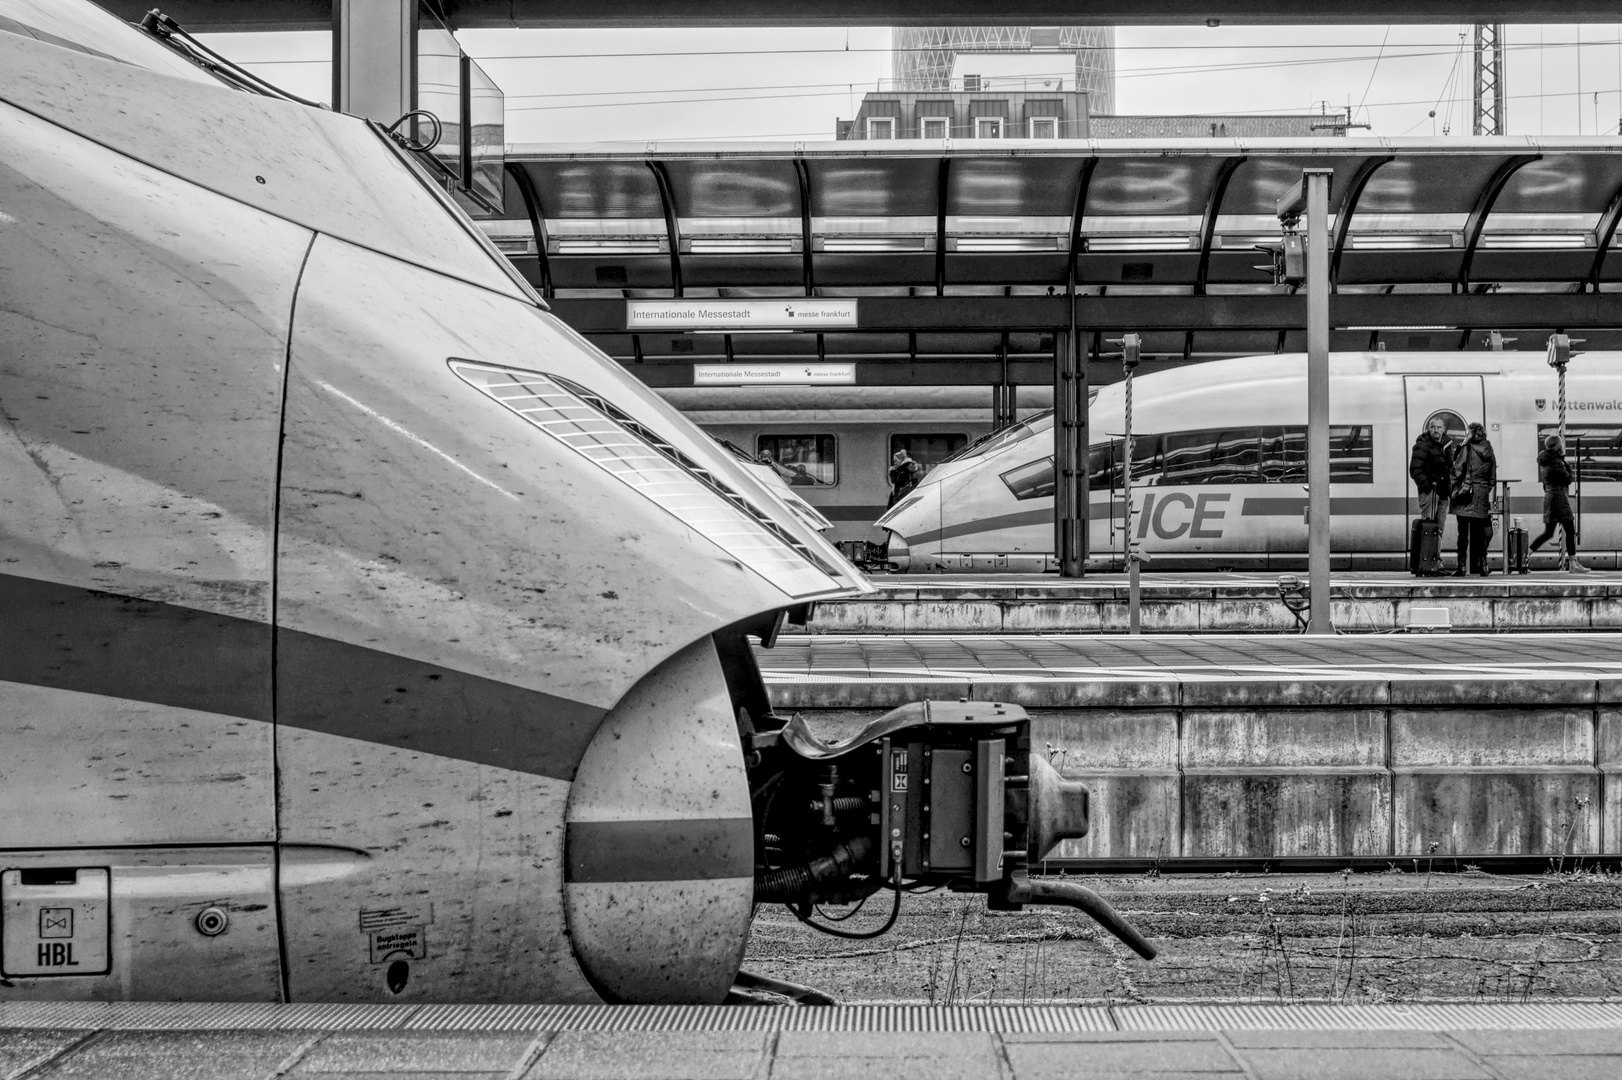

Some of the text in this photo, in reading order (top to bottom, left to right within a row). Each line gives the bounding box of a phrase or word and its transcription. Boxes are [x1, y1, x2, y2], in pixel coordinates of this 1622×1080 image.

[633, 309, 751, 319] Internationale Messestadt
[821, 310, 851, 318] frankfurt
[1136, 492, 1231, 539] ICE
[38, 942, 79, 966] HBL
